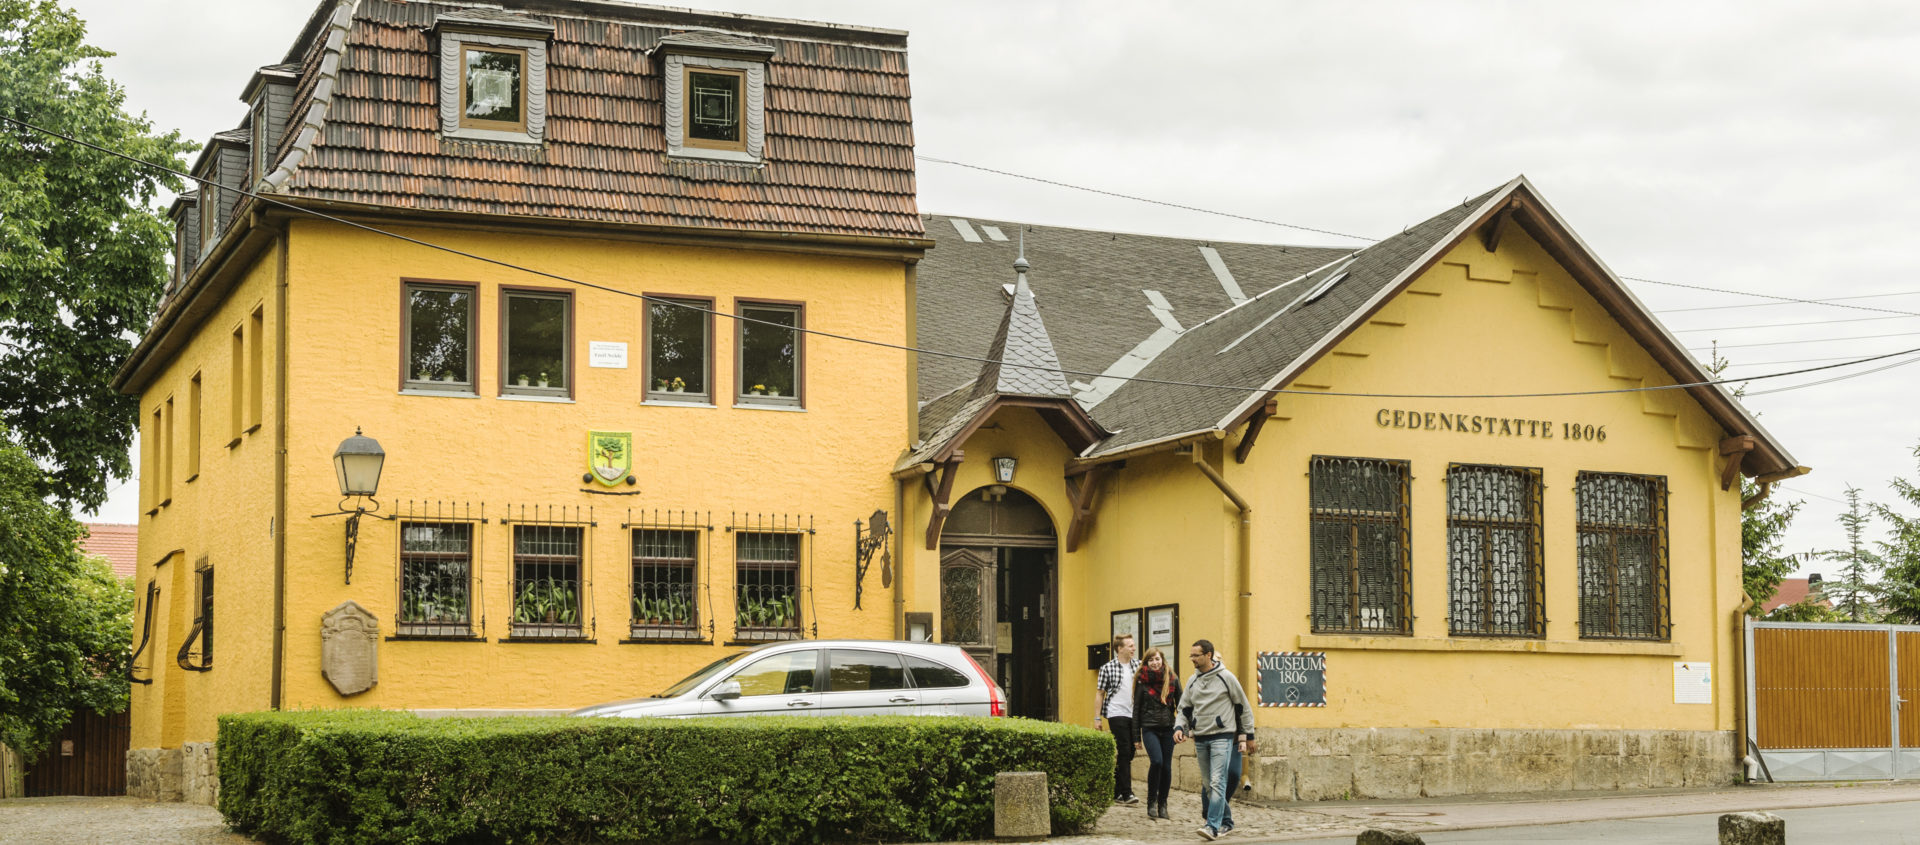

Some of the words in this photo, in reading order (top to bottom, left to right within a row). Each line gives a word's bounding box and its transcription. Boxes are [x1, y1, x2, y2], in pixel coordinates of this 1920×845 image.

[1376, 408, 1553, 438] GEDENKSTÄTTE
[1562, 422, 1607, 441] 1806
[1261, 656, 1324, 671] MUSEUM
[1279, 670, 1308, 684] 1806
